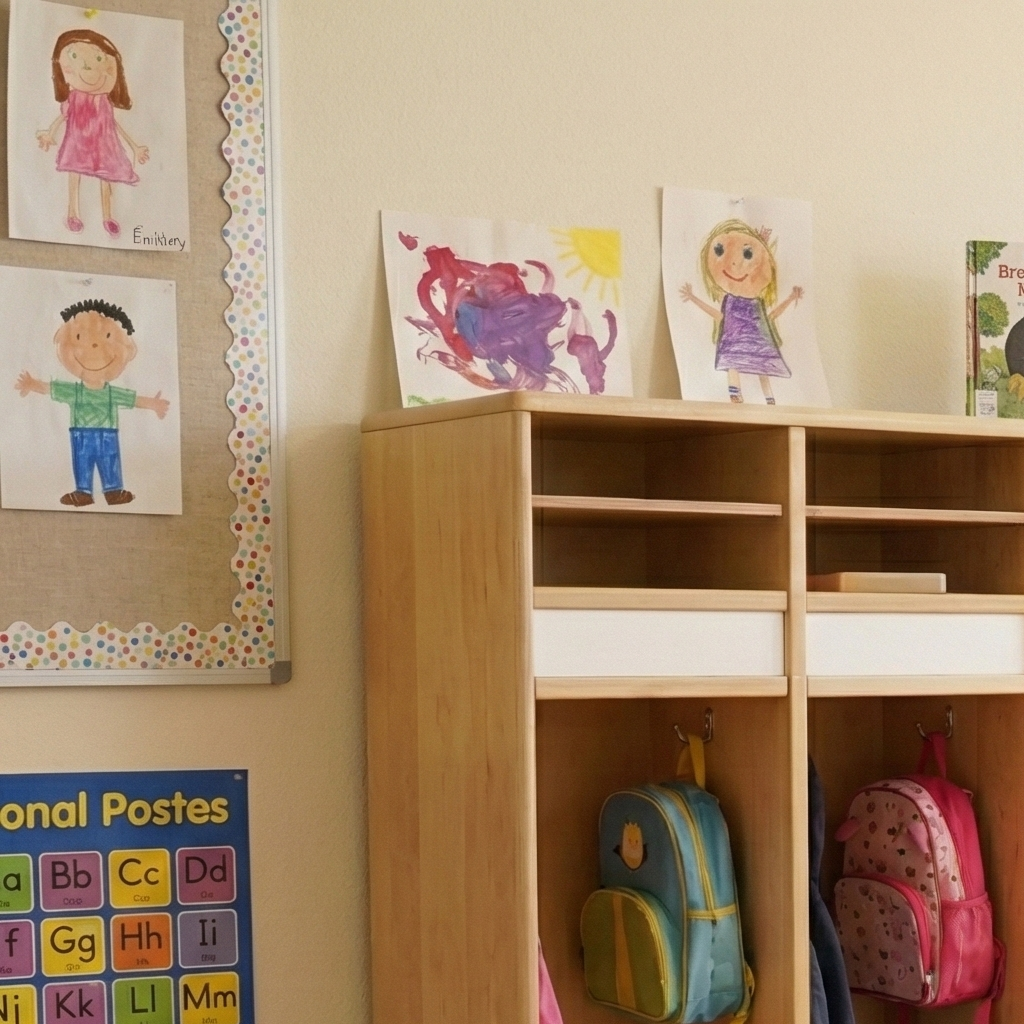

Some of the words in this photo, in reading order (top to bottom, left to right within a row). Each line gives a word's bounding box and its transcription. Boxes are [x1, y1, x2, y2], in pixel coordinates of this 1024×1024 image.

[0, 791, 88, 831] onal
[102, 791, 229, 827] Postes
[51, 859, 92, 889] Bb
[118, 858, 160, 886] Cc
[184, 854, 227, 884] Dd
[50, 926, 96, 963] Gg
[120, 922, 162, 950] Hh
[199, 919, 217, 946] Ii
[56, 989, 94, 1019] Kk
[130, 985, 156, 1014] Ll
[183, 983, 237, 1010] Mm
